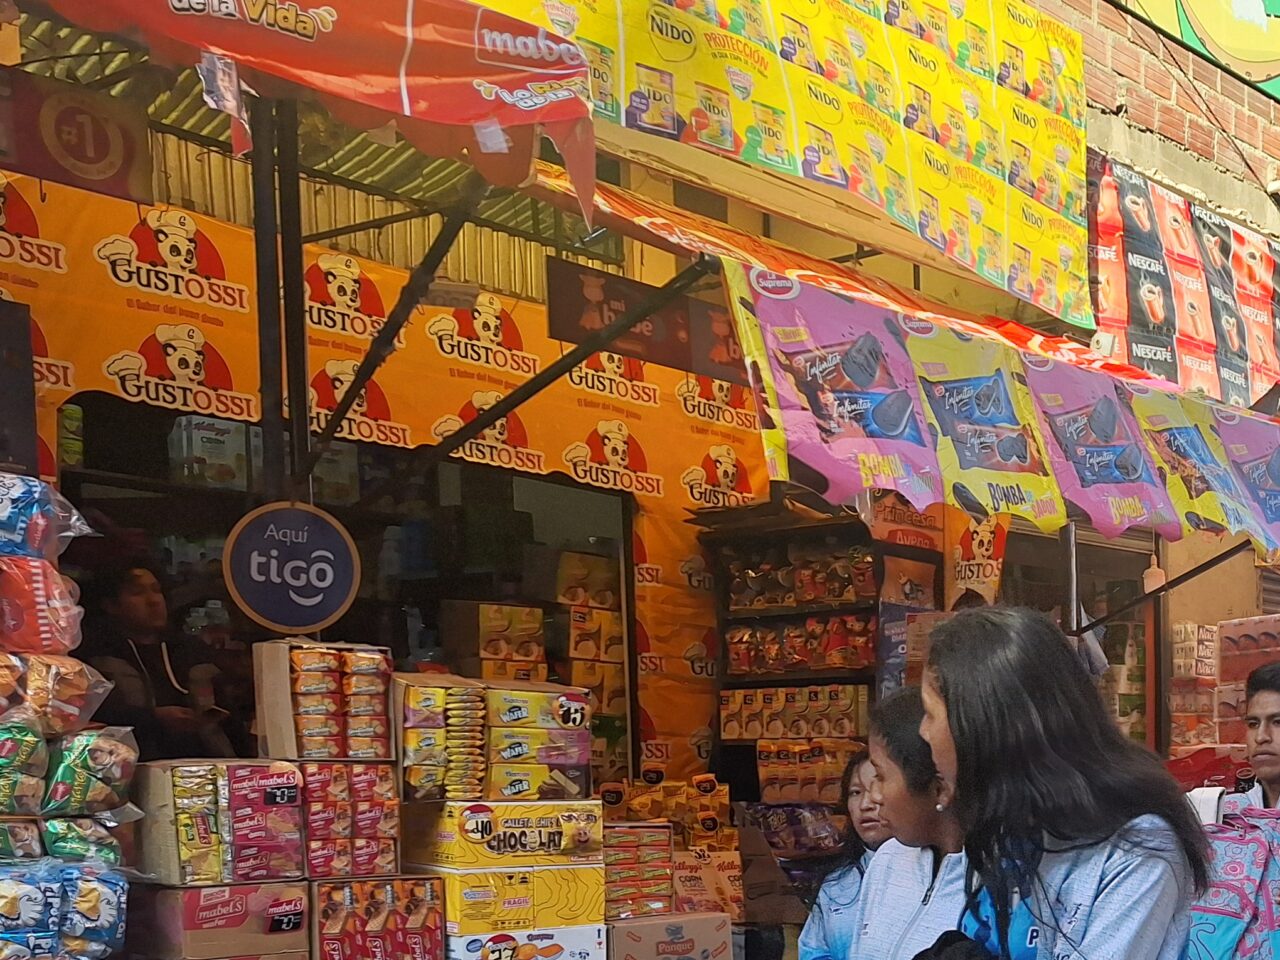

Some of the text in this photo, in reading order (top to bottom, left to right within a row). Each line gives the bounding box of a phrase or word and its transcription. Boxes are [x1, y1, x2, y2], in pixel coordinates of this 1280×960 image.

[244, 0, 317, 41] Vida
[651, 14, 694, 45] NIDO
[703, 31, 770, 72] PROTECCIÓN
[908, 47, 937, 73] NIDO
[807, 84, 840, 111] NIDO
[1012, 106, 1037, 129] NIDO
[923, 150, 949, 176] NIDO
[1021, 206, 1043, 229] NIDO
[111, 258, 247, 309] GUSTOSSI
[438, 333, 540, 375] GUSTOSSI
[119, 374, 255, 418] GUSTOSSI
[569, 370, 659, 405] GUSTOSSI
[573, 460, 662, 495] GUSTOSSI
[987, 482, 1026, 512] BOMBA
[263, 523, 310, 546] Aquí
